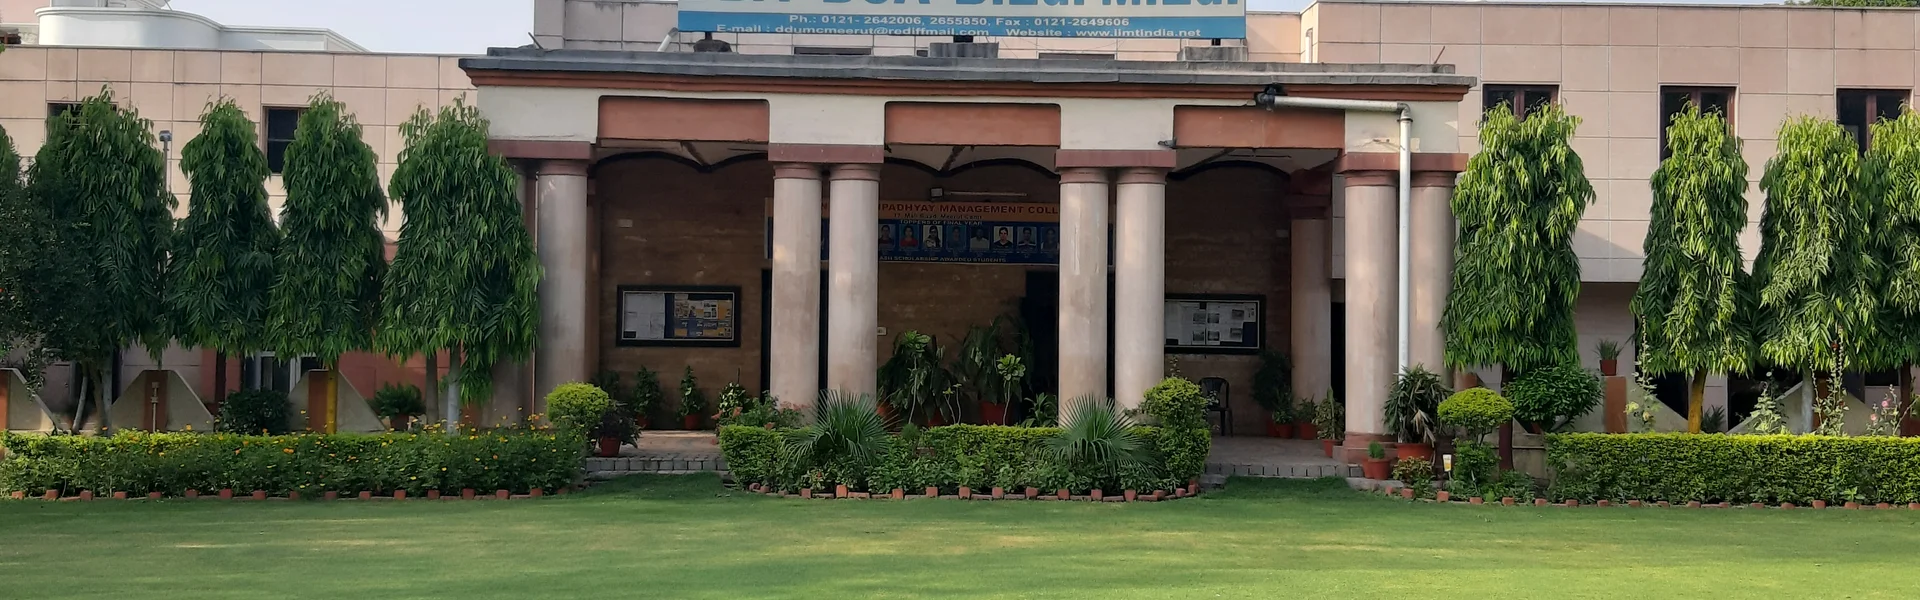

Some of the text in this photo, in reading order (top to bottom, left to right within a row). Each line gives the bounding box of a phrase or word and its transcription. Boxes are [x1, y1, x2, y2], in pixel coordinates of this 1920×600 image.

[822, 15, 860, 24] 0121-
[864, 16, 925, 25] 2642006,
[930, 17, 991, 26] 2655850,
[996, 18, 1021, 26] Fax
[1034, 18, 1130, 26] 0121-2649606
[879, 204, 936, 212] PADHYAY
[940, 204, 1024, 213] MANAGEMENT
